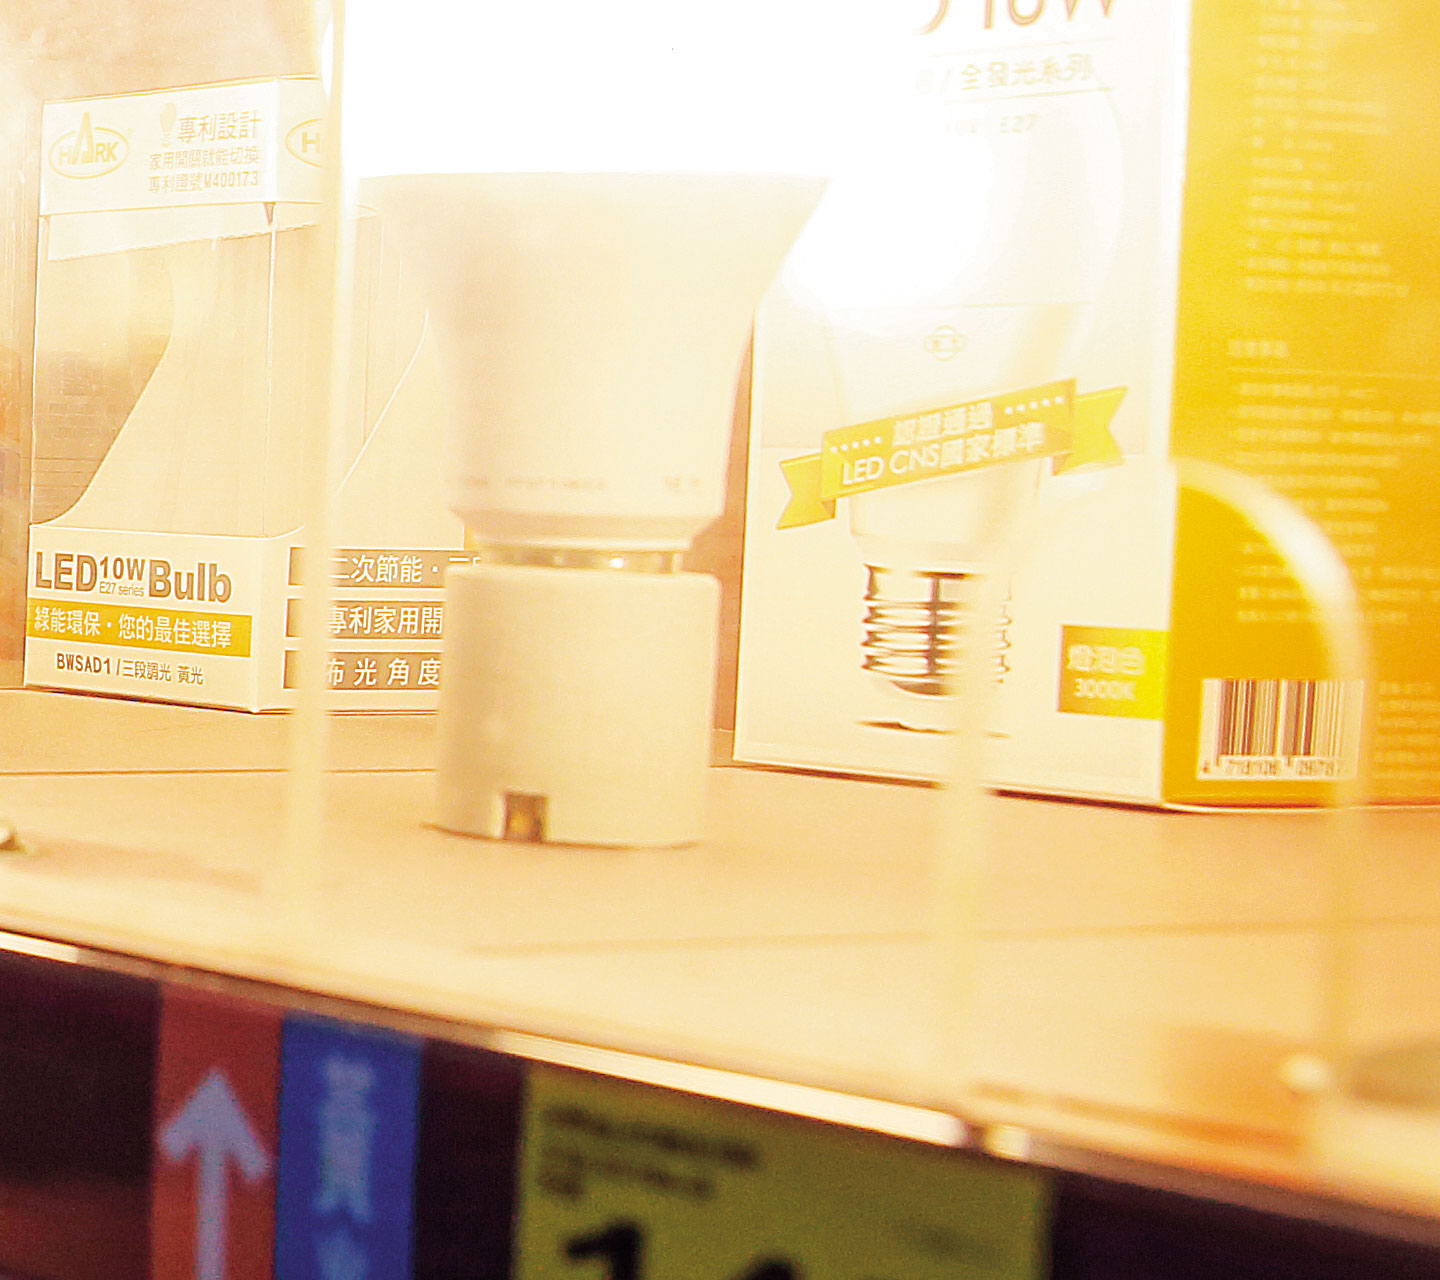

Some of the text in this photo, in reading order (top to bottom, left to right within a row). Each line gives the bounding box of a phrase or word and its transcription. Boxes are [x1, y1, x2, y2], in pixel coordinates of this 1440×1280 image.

[178, 109, 263, 143] 專利設計
[843, 457, 886, 485] LED
[35, 551, 232, 603] LED 10W Bulb
[100, 581, 144, 597] E27 series
[56, 653, 111, 675] BWSAD1
[177, 665, 204, 685] 黃光
